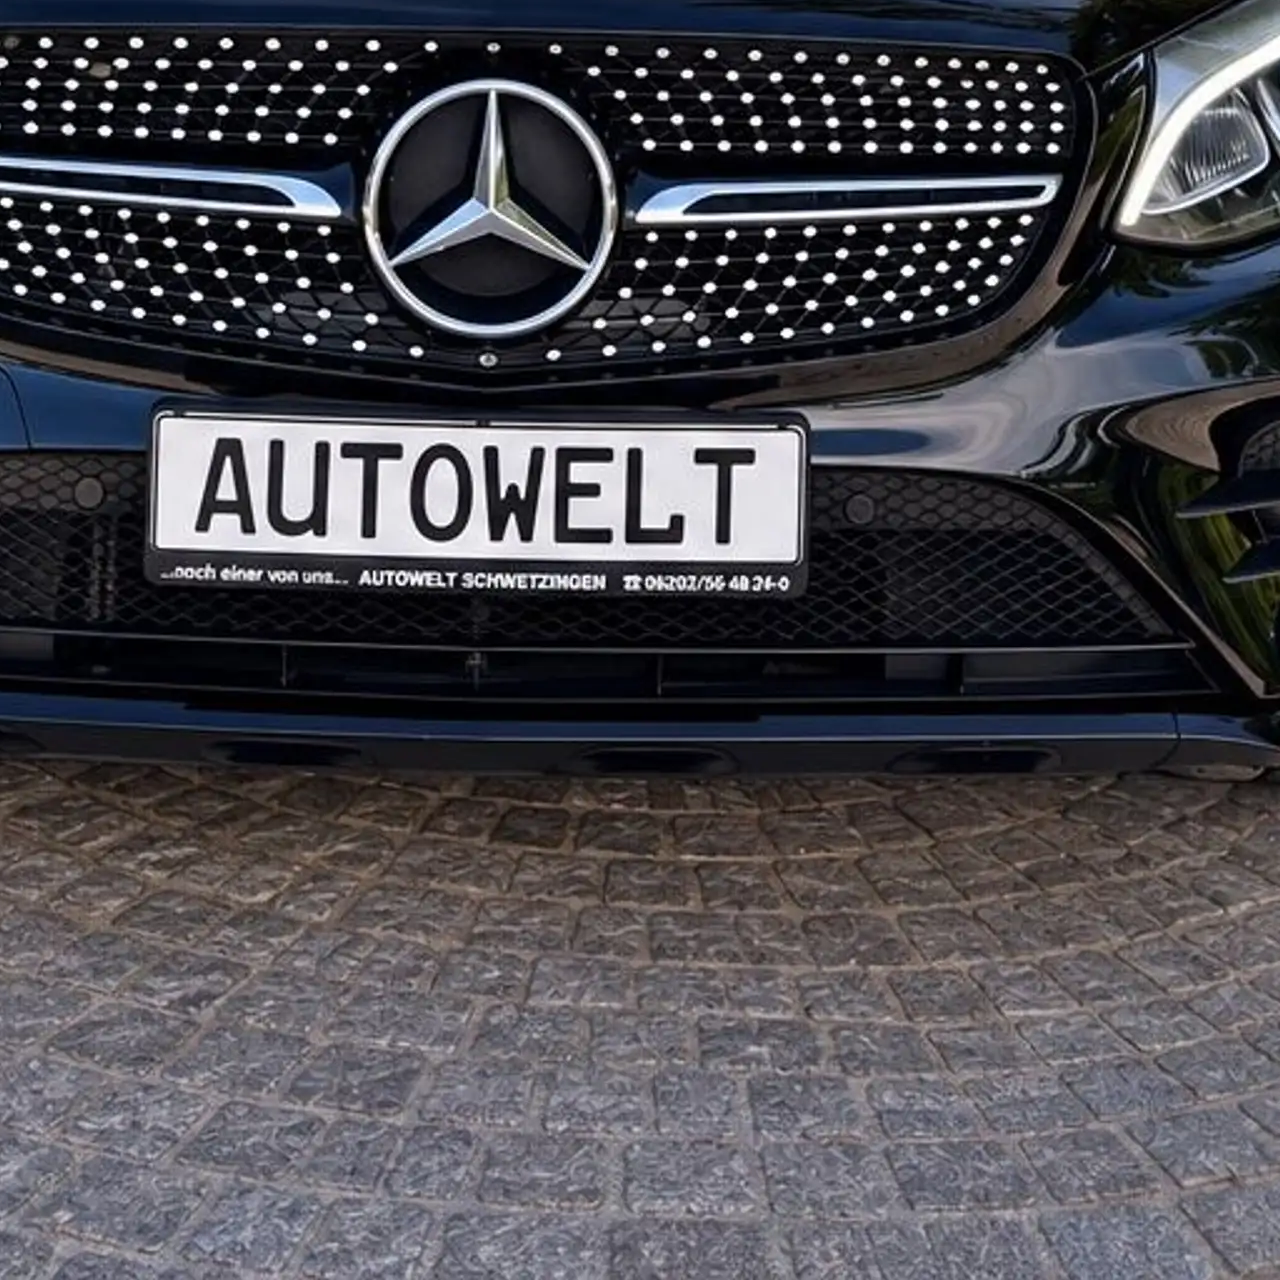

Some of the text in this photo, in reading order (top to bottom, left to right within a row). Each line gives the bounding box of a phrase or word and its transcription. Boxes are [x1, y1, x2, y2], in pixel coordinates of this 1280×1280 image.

[195, 437, 756, 544] AUTOWELT
[220, 565, 263, 582] einer
[268, 570, 299, 583] von
[358, 570, 458, 588] AUTOWELT
